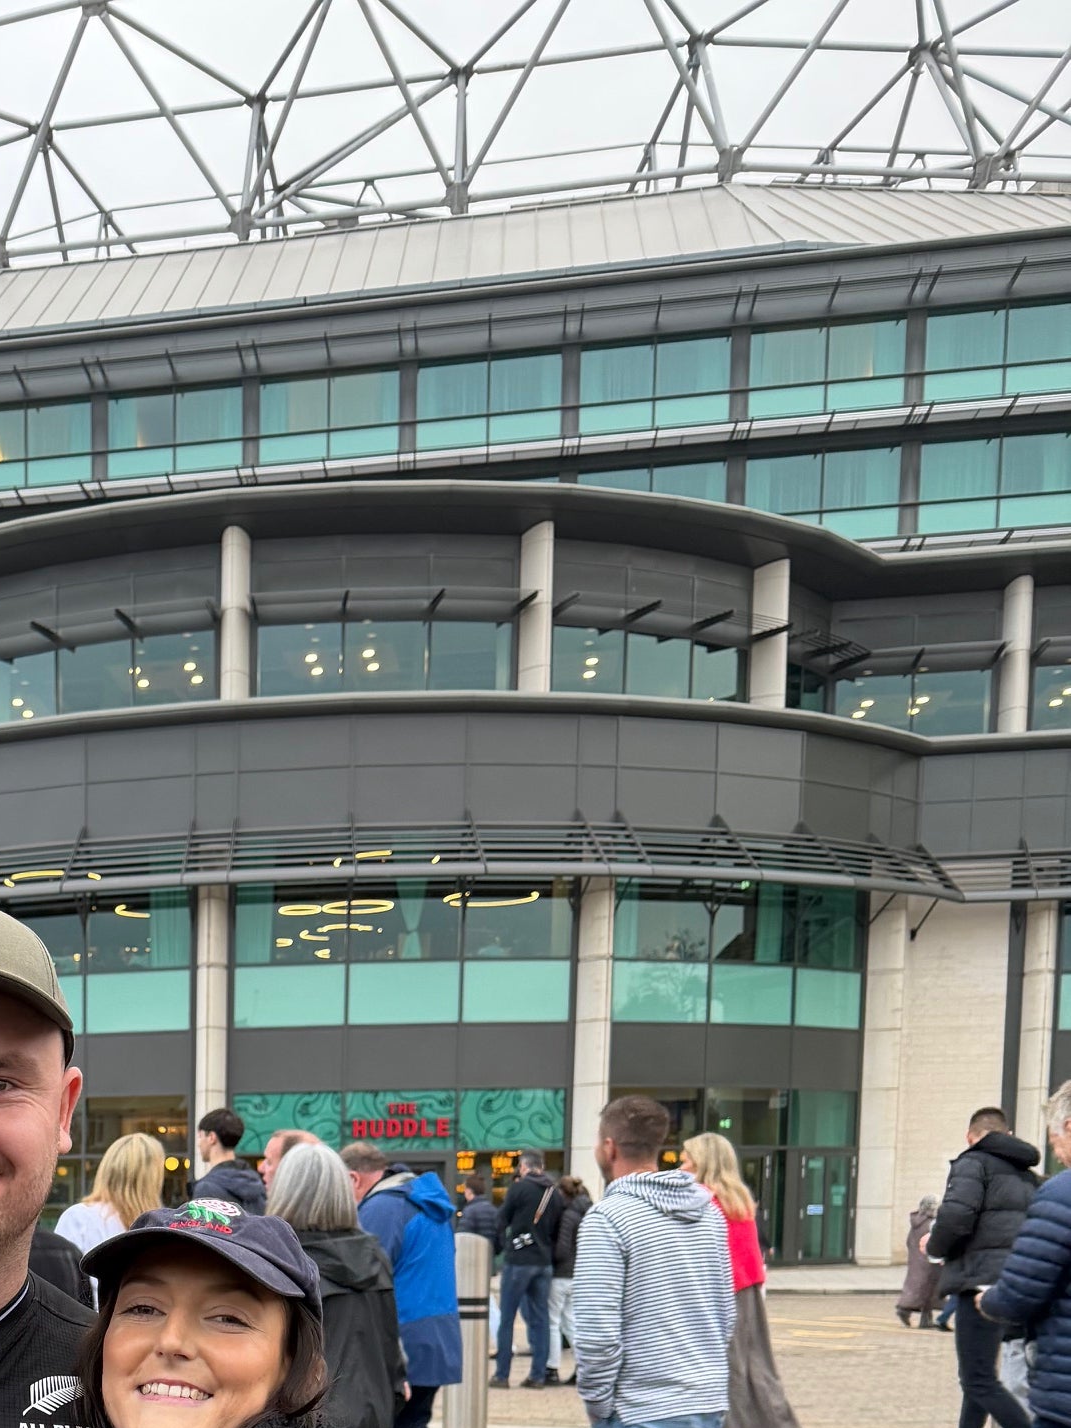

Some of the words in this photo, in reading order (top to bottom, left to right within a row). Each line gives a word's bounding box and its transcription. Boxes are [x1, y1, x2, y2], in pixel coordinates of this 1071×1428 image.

[388, 1103, 417, 1115] THE
[352, 1118, 451, 1138] HUDDLE
[169, 1220, 233, 1235] ENGLAND
